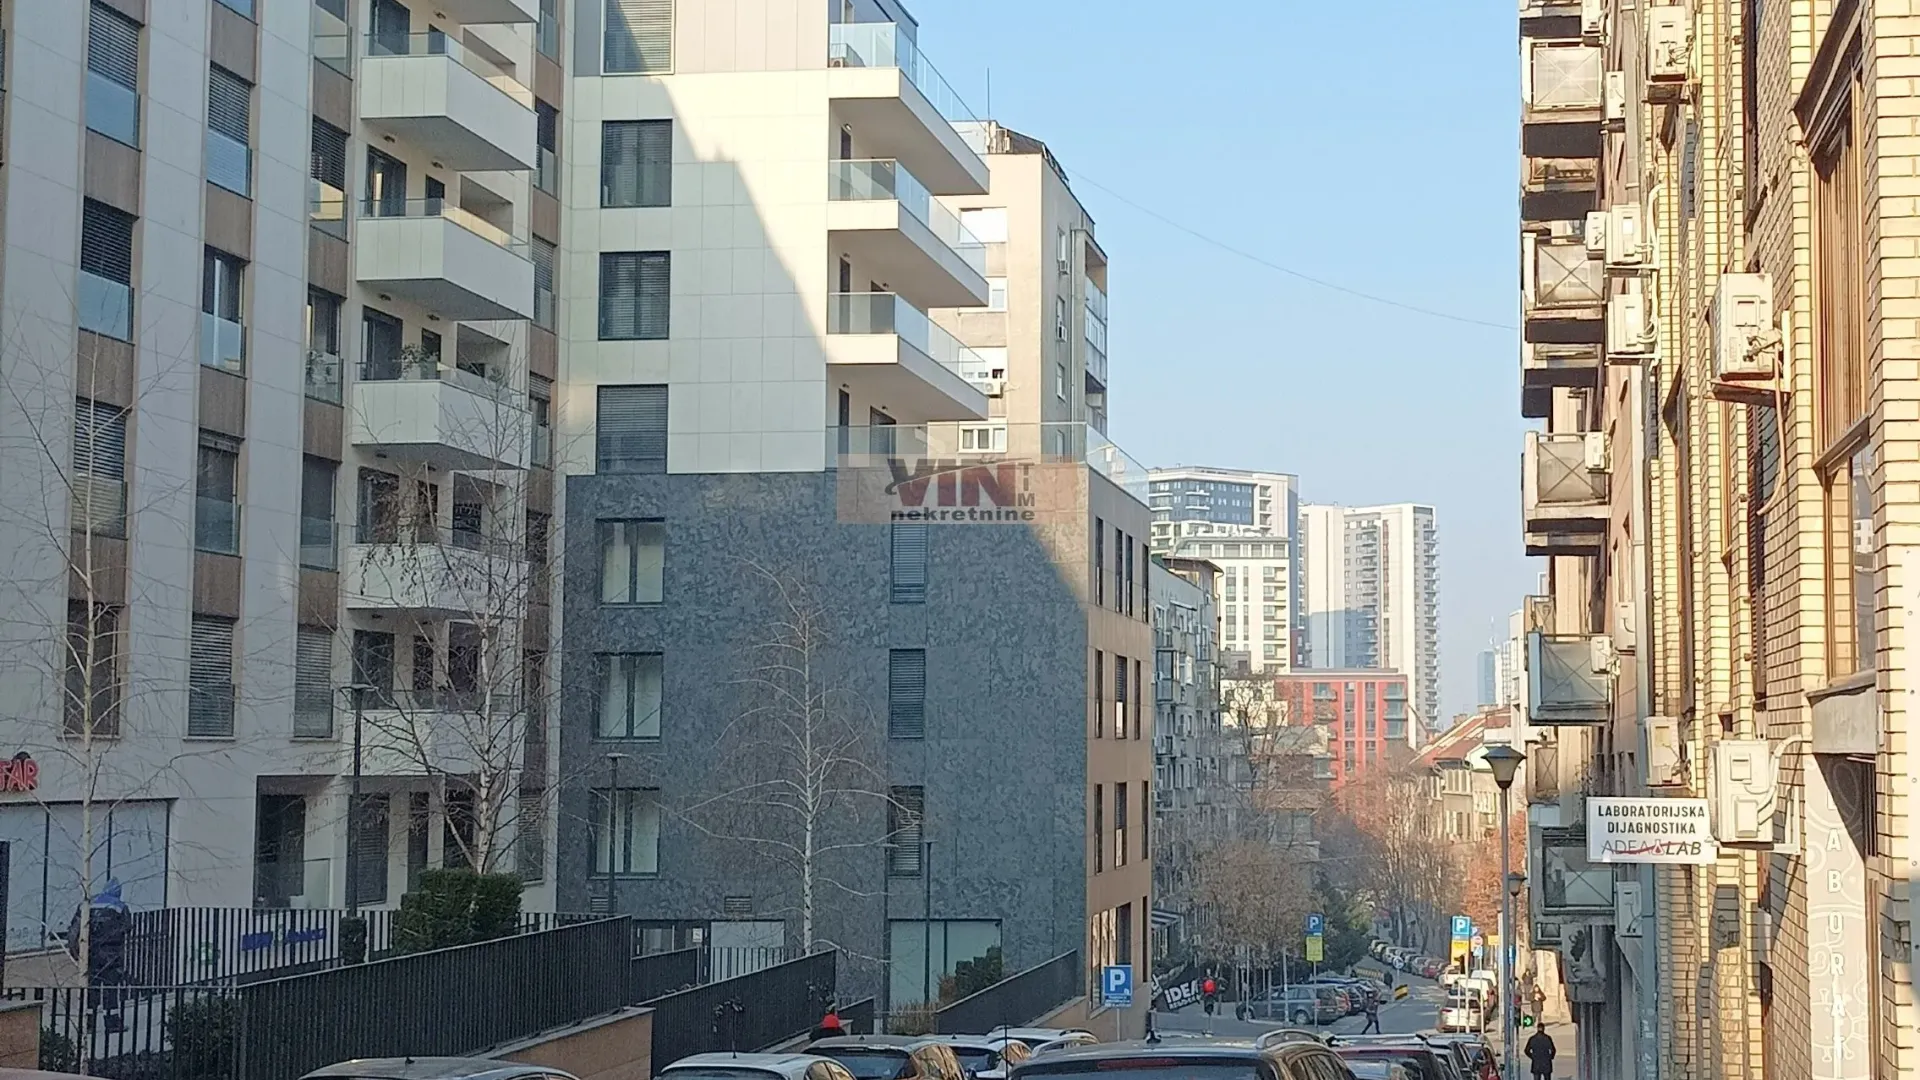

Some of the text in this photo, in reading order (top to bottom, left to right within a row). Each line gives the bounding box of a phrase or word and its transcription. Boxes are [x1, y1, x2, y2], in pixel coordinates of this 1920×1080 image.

[1598, 805, 1705, 818] LABORATORIJSKA
[1607, 821, 1696, 834] DIJAGNOSTIKA
[1309, 916, 1319, 929] P
[1456, 919, 1466, 932] P
[1109, 968, 1126, 992] P
